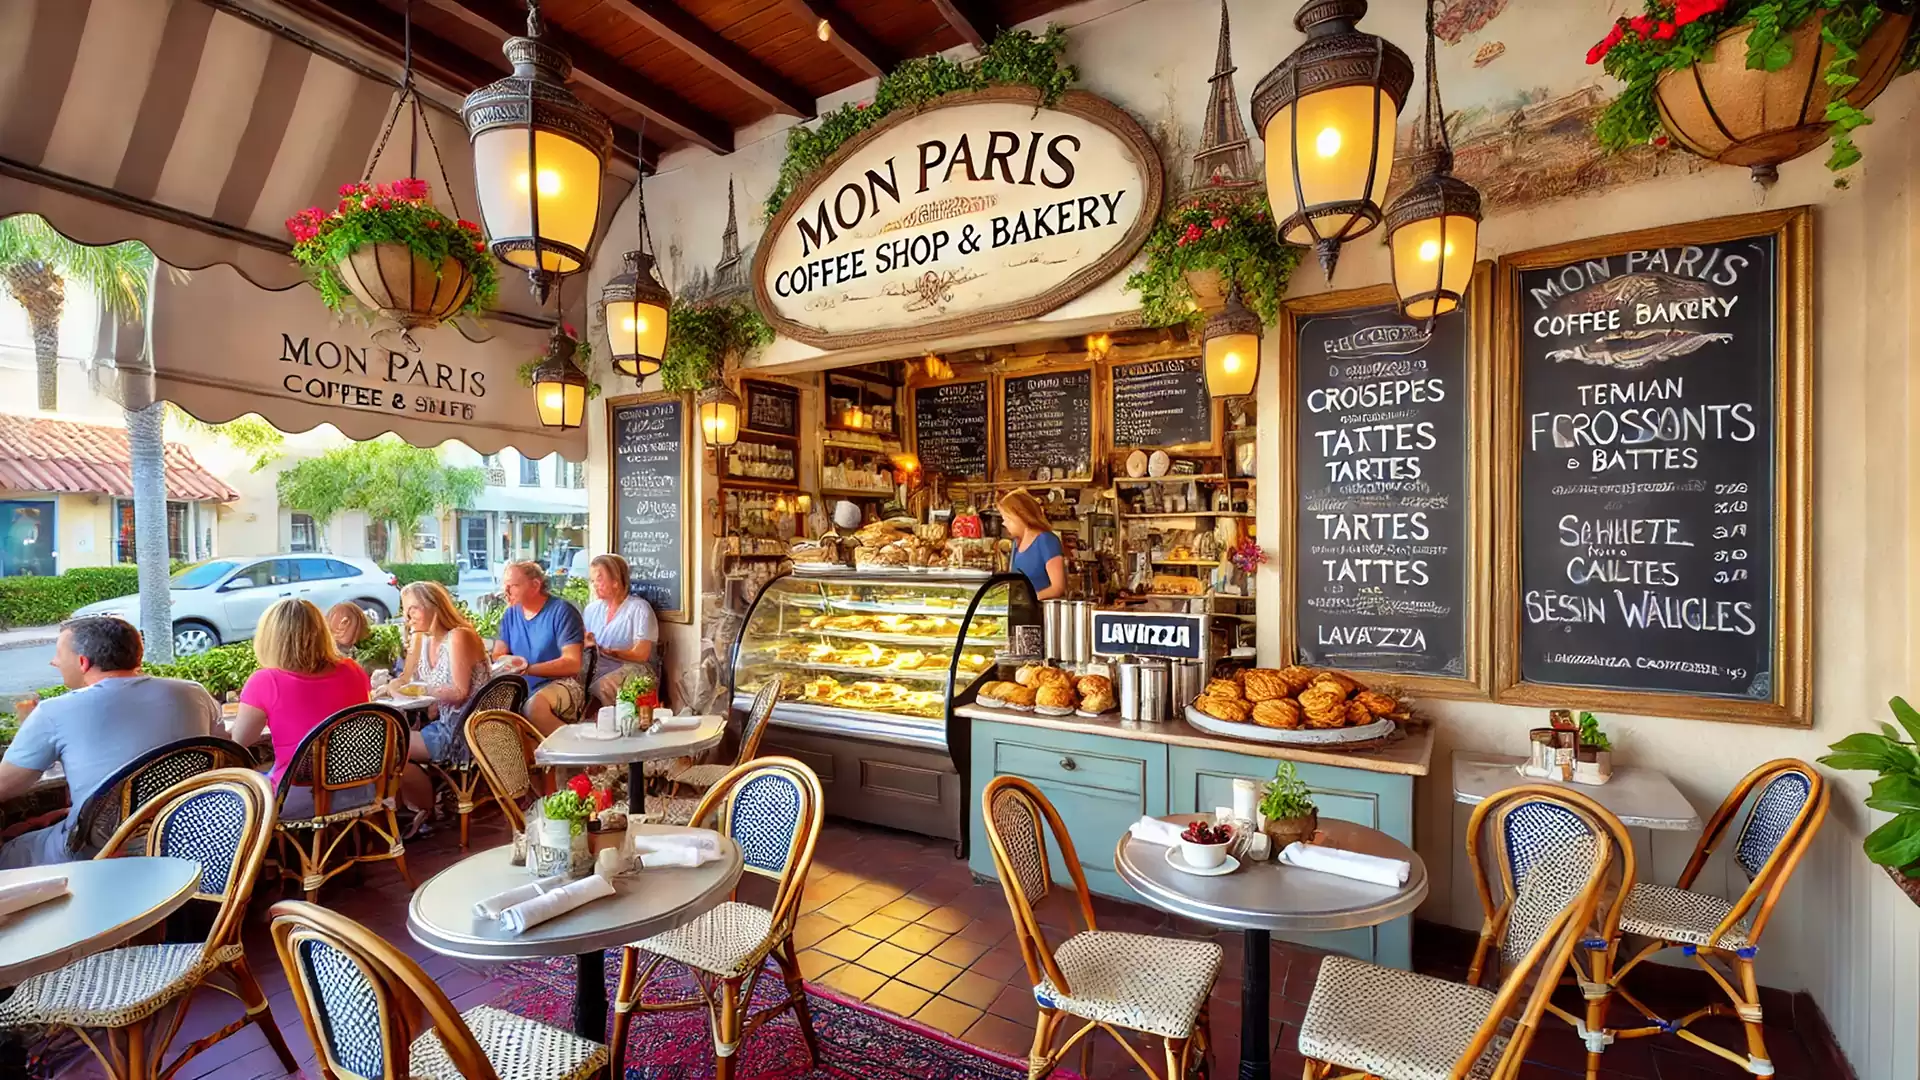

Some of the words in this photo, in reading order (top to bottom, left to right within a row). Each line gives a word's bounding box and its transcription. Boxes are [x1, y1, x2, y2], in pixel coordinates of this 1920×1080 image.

[796, 157, 902, 257] MON
[914, 130, 1081, 195] PARIS
[775, 248, 867, 298] COFFEE
[875, 229, 950, 274] SHOP
[958, 223, 981, 254] &
[990, 190, 1126, 249] BAKERY
[1530, 257, 1611, 310] MON
[1625, 245, 1749, 287] PARIS
[1533, 309, 1621, 338] COFFEE
[1635, 295, 1740, 326] BAKERY
[279, 333, 368, 375] MON
[382, 350, 487, 398] PARIS
[1324, 456, 1422, 482] TARTES
[1591, 447, 1699, 473] BATTES
[1316, 511, 1430, 541] TARTES
[1322, 558, 1430, 586] TATTES
[1318, 624, 1427, 651] LAVAZZA
